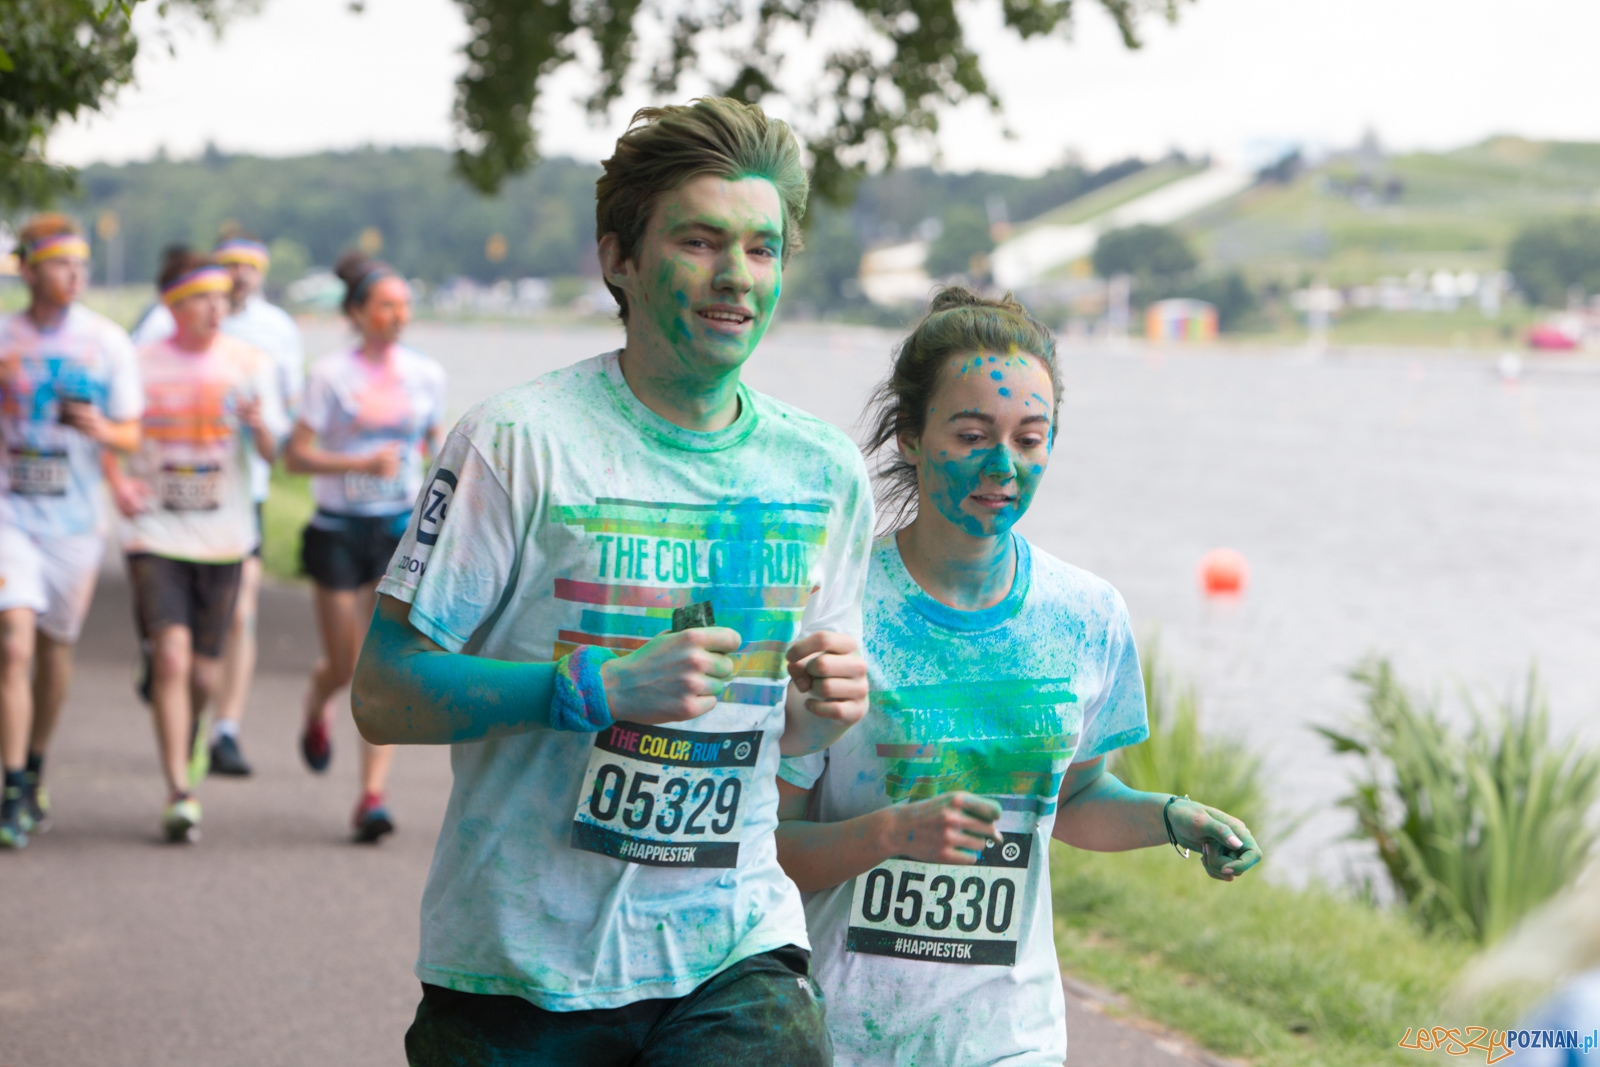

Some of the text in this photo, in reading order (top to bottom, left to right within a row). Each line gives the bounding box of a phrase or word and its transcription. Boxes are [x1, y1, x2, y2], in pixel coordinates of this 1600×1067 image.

[595, 534, 808, 585] THE COLO RUN
[610, 725, 721, 762] THE COLOR RUN
[589, 763, 742, 835] 05329
[619, 840, 698, 862] #HAPPIEST5K
[862, 868, 1016, 934] 05330
[894, 937, 973, 959] #HAPPIEST5K
